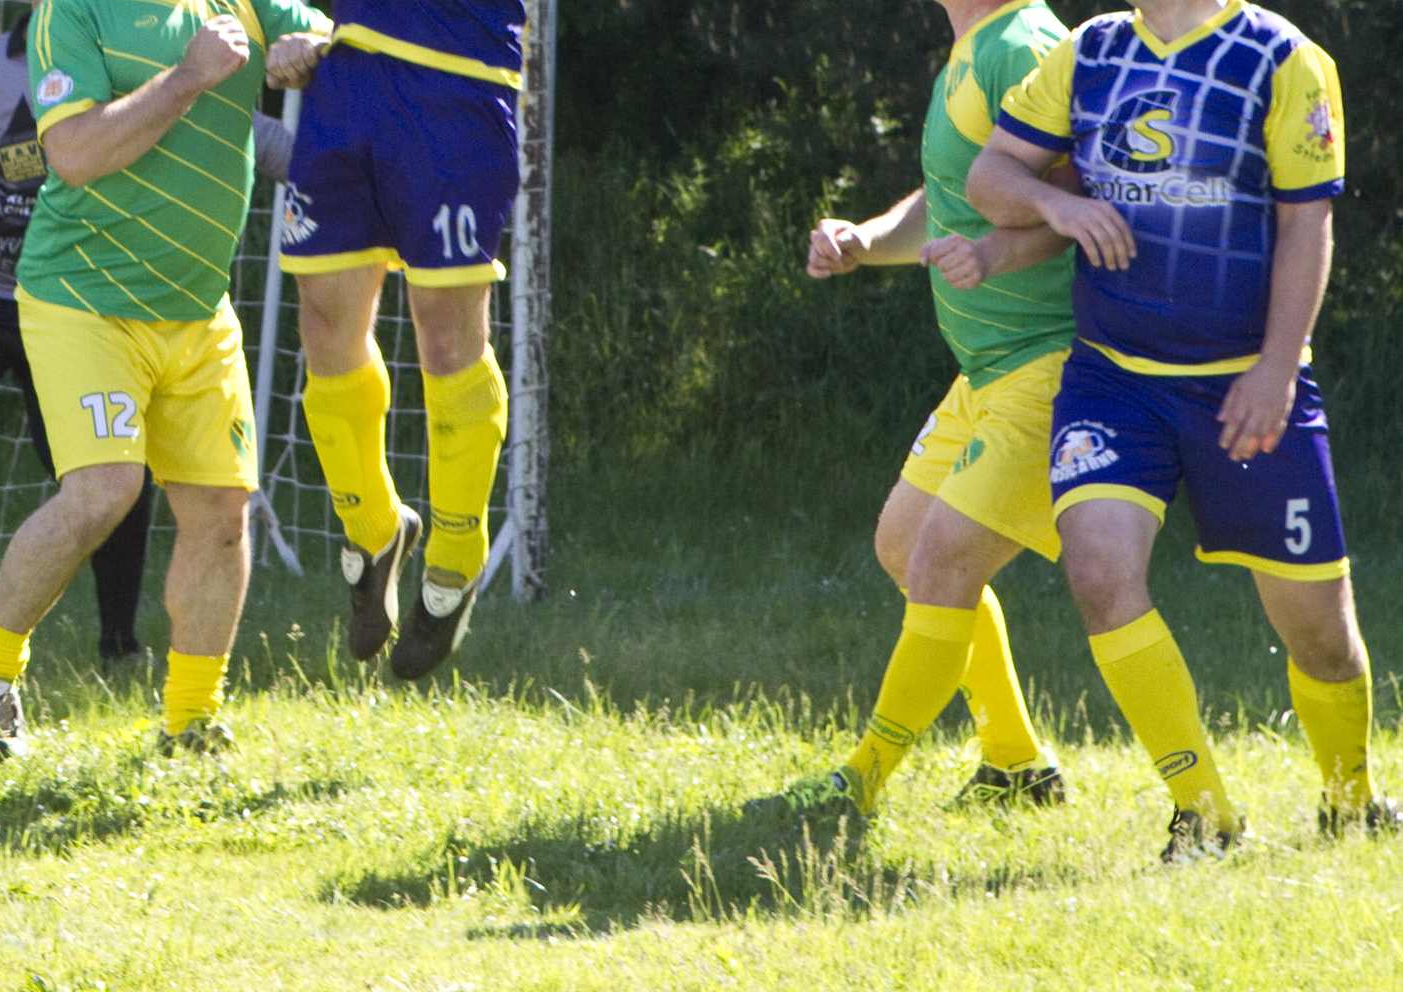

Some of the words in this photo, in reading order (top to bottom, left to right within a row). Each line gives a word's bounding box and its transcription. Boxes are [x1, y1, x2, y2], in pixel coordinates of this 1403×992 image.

[433, 204, 480, 258] 10
[81, 392, 140, 439] 12
[1284, 498, 1312, 555] 5
